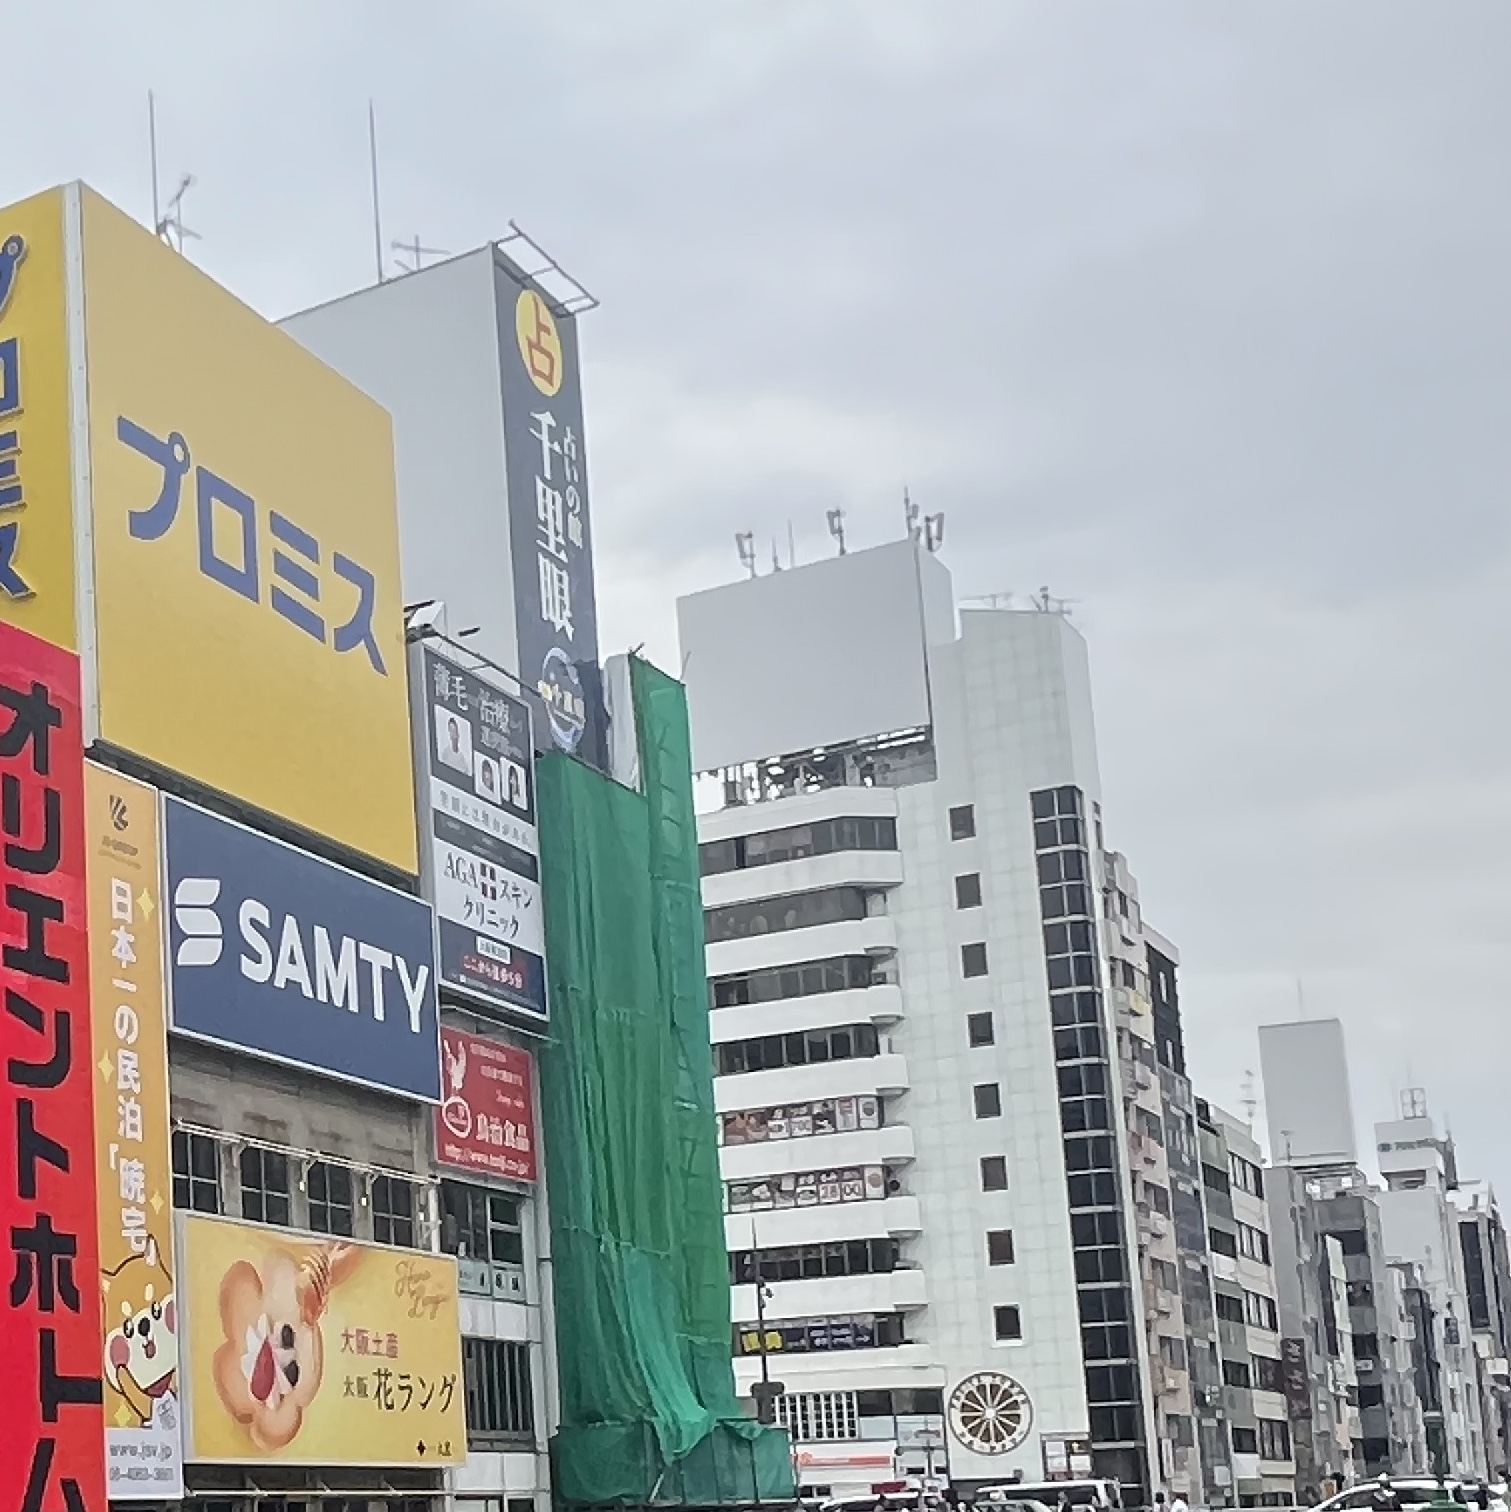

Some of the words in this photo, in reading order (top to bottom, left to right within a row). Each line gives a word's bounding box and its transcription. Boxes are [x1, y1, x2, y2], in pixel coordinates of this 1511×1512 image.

[117, 415, 388, 677] プロミス
[529, 410, 574, 641] 千里眼
[444, 851, 478, 888] AGA
[463, 894, 519, 938] クリニック
[239, 899, 429, 1033] SAMTY
[372, 1366, 457, 1414] 花ラング
